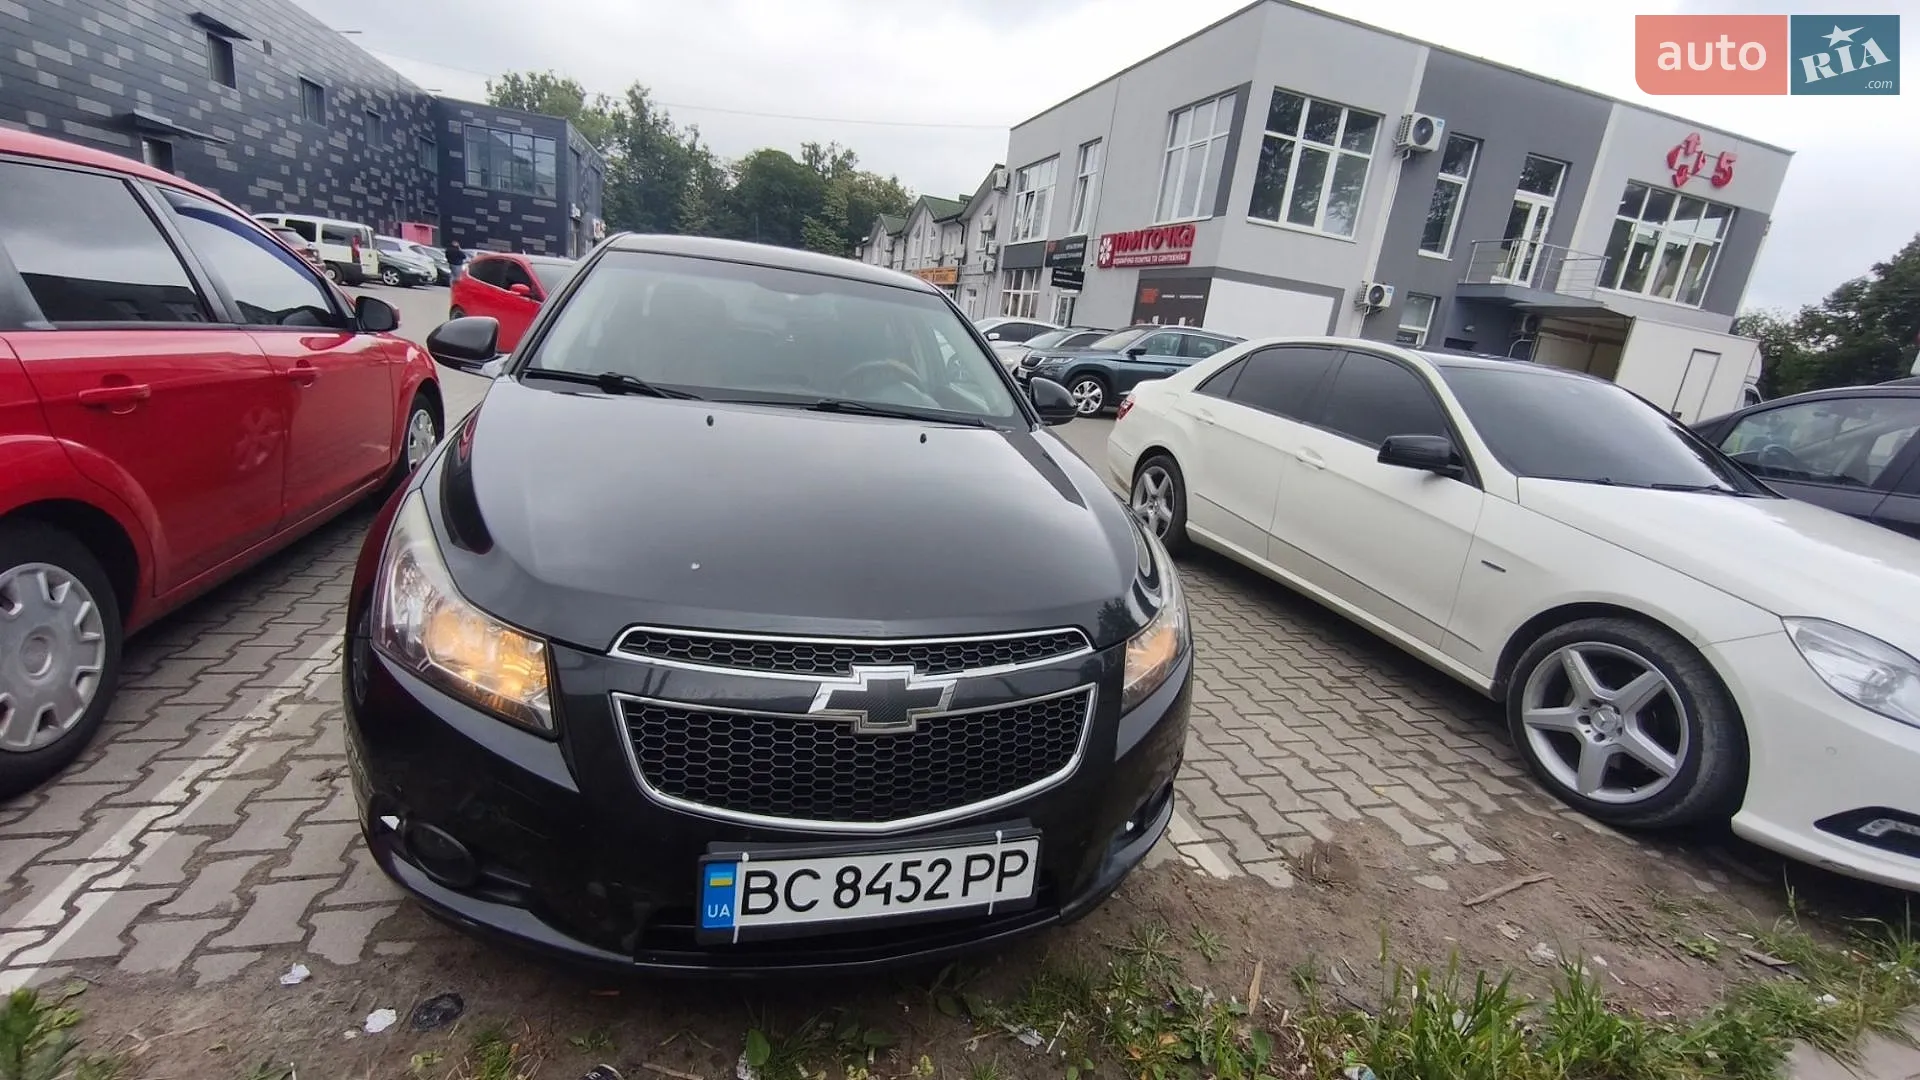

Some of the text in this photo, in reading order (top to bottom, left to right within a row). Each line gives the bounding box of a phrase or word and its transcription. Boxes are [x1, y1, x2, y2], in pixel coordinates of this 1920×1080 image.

[740, 849, 1029, 915] BC 8452 PP
[707, 903, 731, 919] UA
